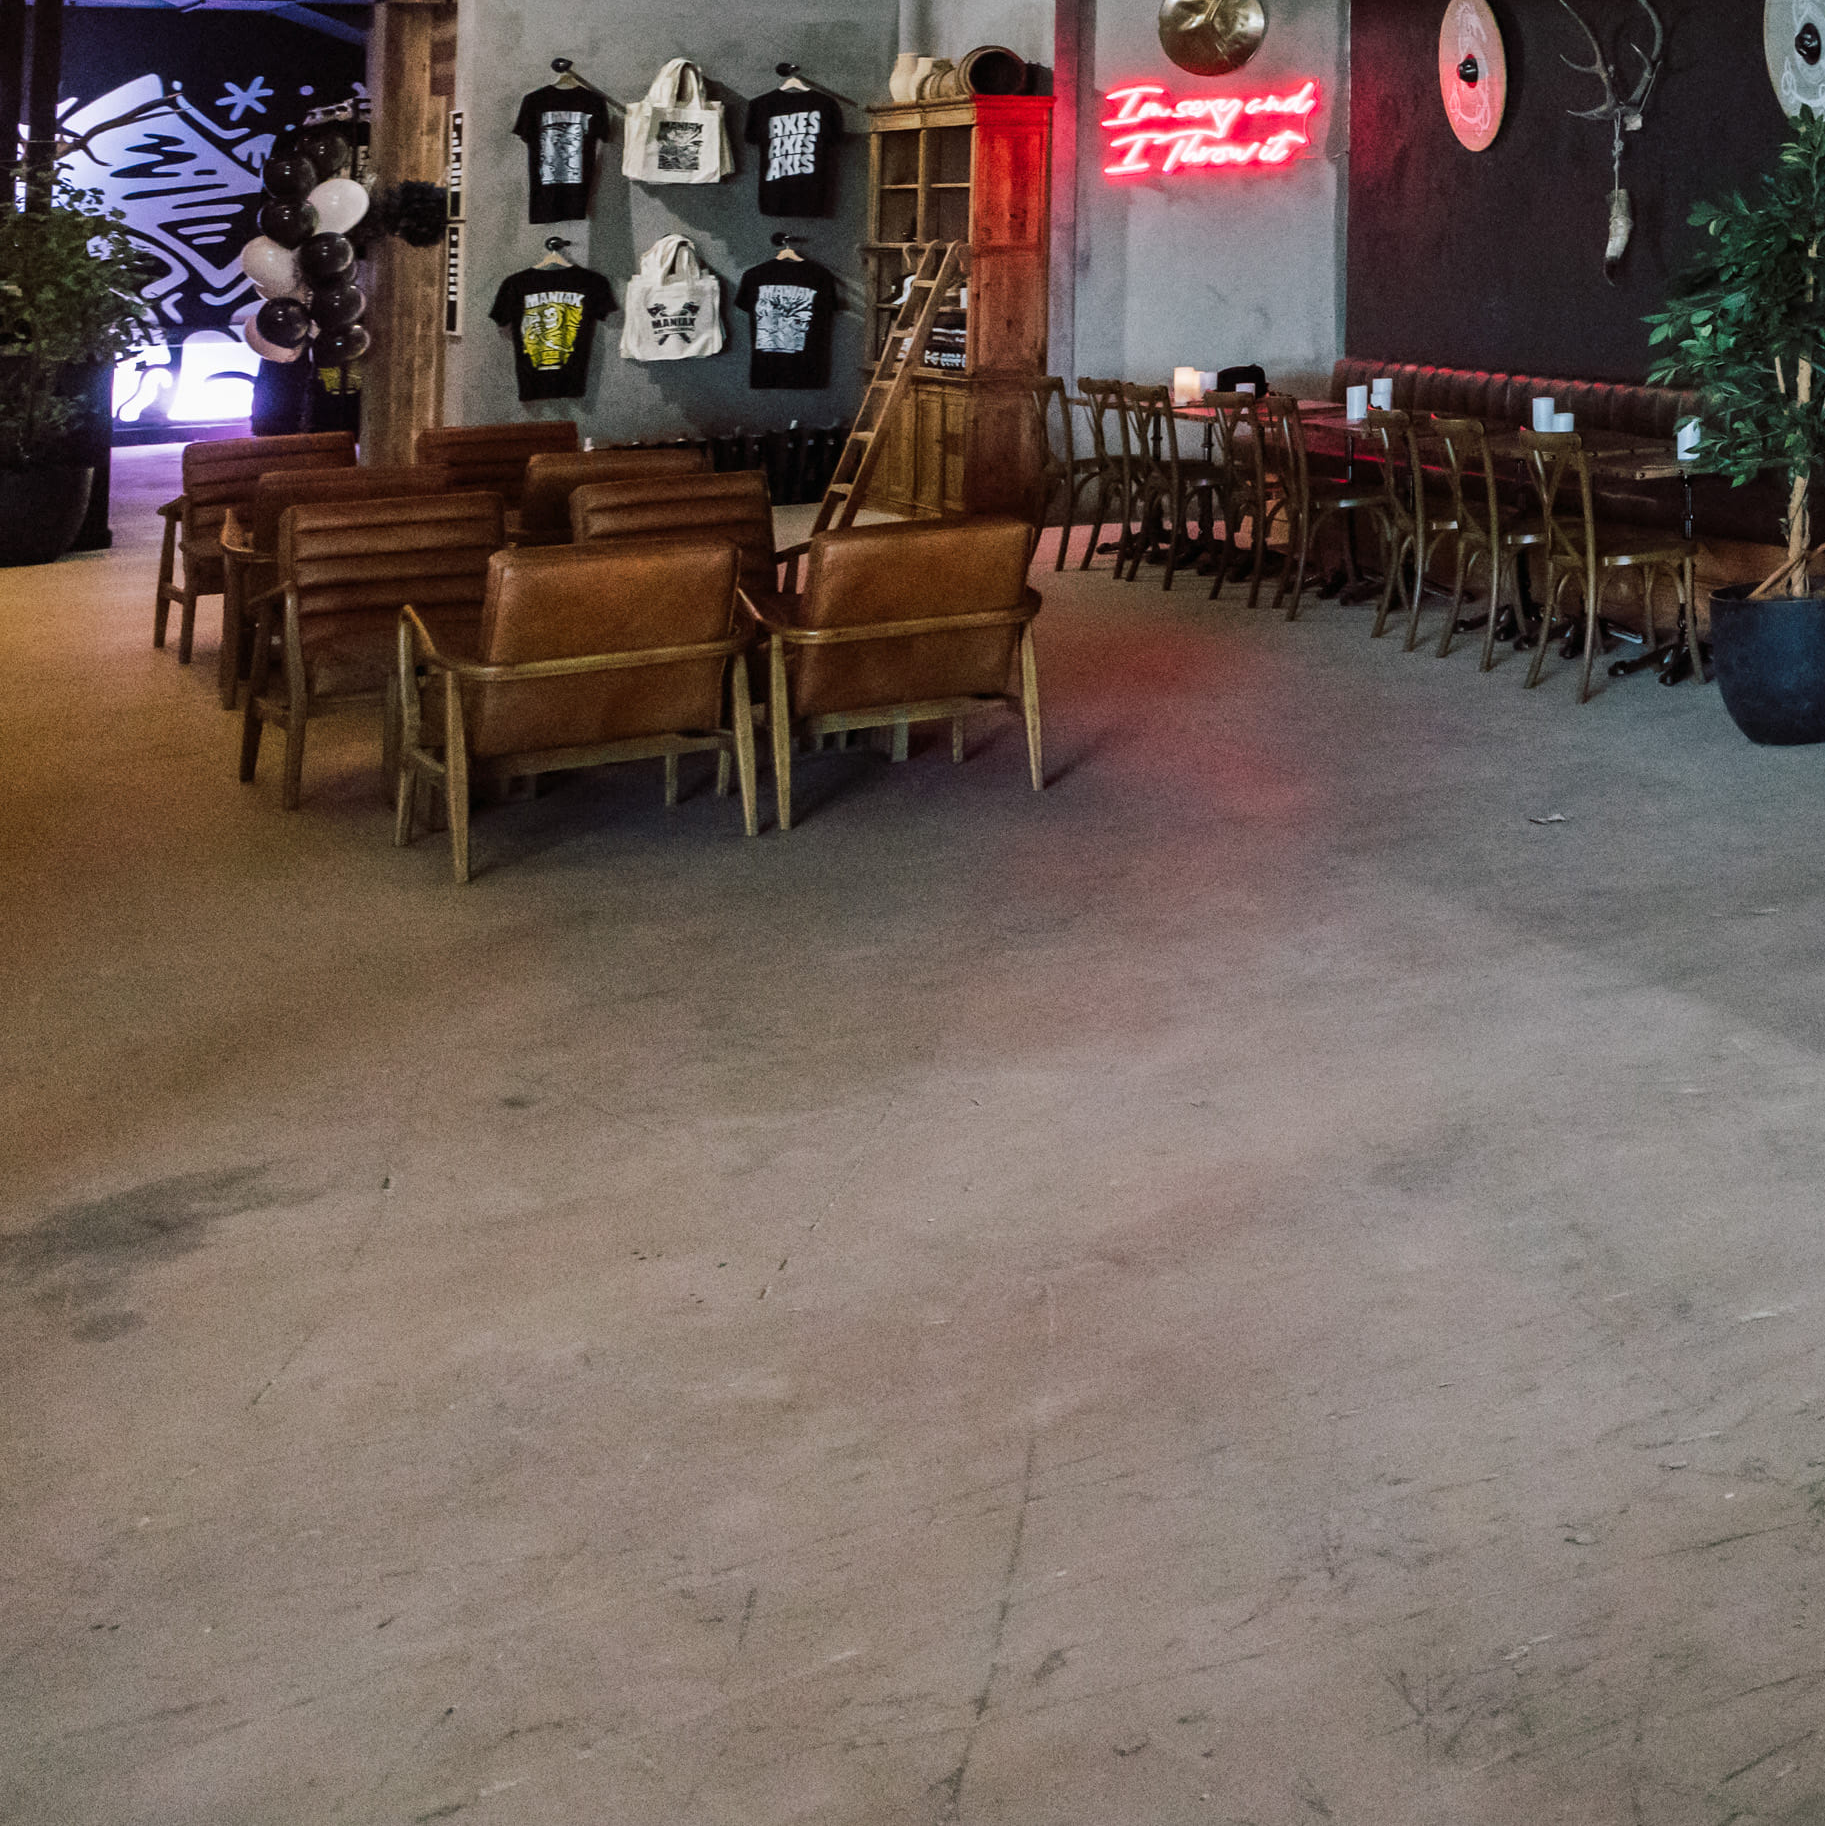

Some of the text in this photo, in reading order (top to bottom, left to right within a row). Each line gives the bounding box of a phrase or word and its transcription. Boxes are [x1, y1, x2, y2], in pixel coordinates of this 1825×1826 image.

[1171, 98, 1244, 138] sexy
[1244, 81, 1316, 115] and
[768, 110, 821, 139] AXES
[768, 133, 817, 160] AXES
[1104, 132, 1158, 173] I
[1257, 129, 1307, 163] it
[765, 153, 815, 182] AXES
[523, 290, 586, 308] MANIAX
[651, 316, 696, 330] MANIAX
